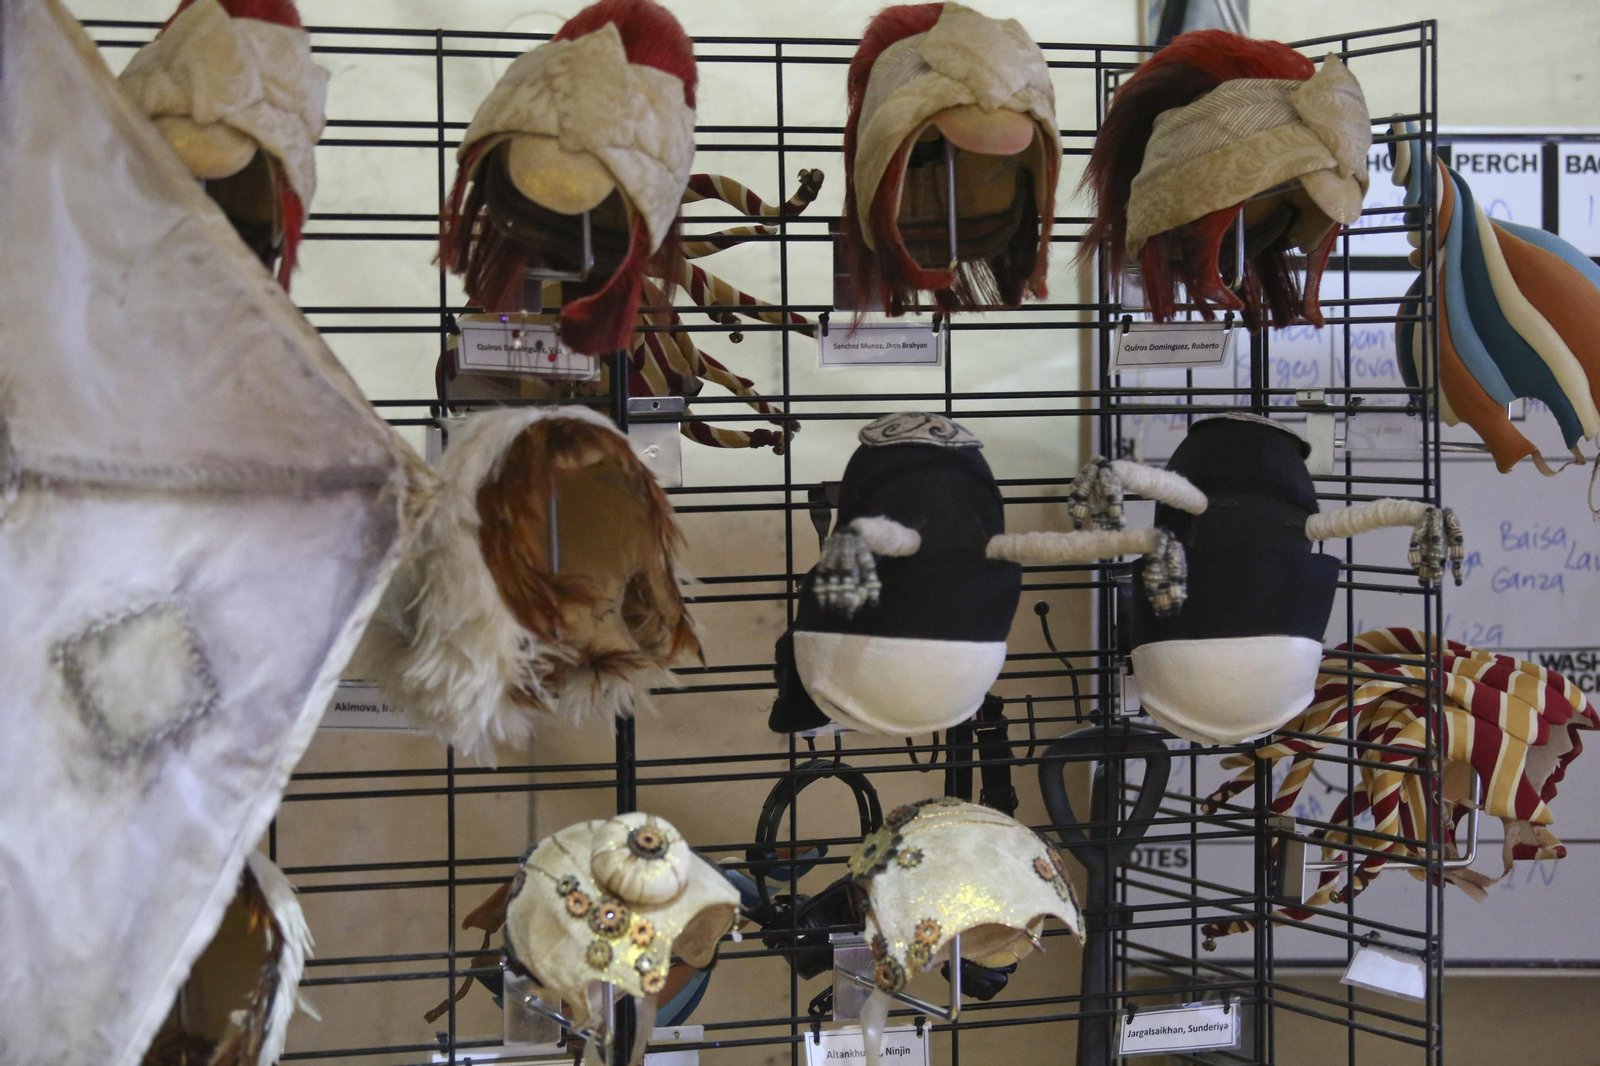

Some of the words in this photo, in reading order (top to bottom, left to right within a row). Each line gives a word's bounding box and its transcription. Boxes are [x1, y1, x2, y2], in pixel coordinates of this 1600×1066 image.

[1455, 153, 1537, 173] PERCH
[1565, 154, 1600, 174] BA
[477, 343, 502, 351] Quiros
[833, 342, 859, 350] Sanchez
[860, 342, 884, 350] Munoz,
[902, 341, 928, 350] Brahyan
[1124, 343, 1148, 352] Quiros
[1149, 343, 1190, 352] Dominguez,
[1191, 342, 1220, 350] Roberto
[1500, 520, 1567, 551] Baisa
[1490, 565, 1565, 595] Ganza
[1539, 653, 1600, 672] WASH
[334, 702, 380, 714] Akimova,
[1127, 847, 1188, 868] OTES
[1127, 1025, 1187, 1039] Jargalsaikhan,
[1188, 1021, 1229, 1033] Sunderiya
[885, 1046, 911, 1057] Ninjin
